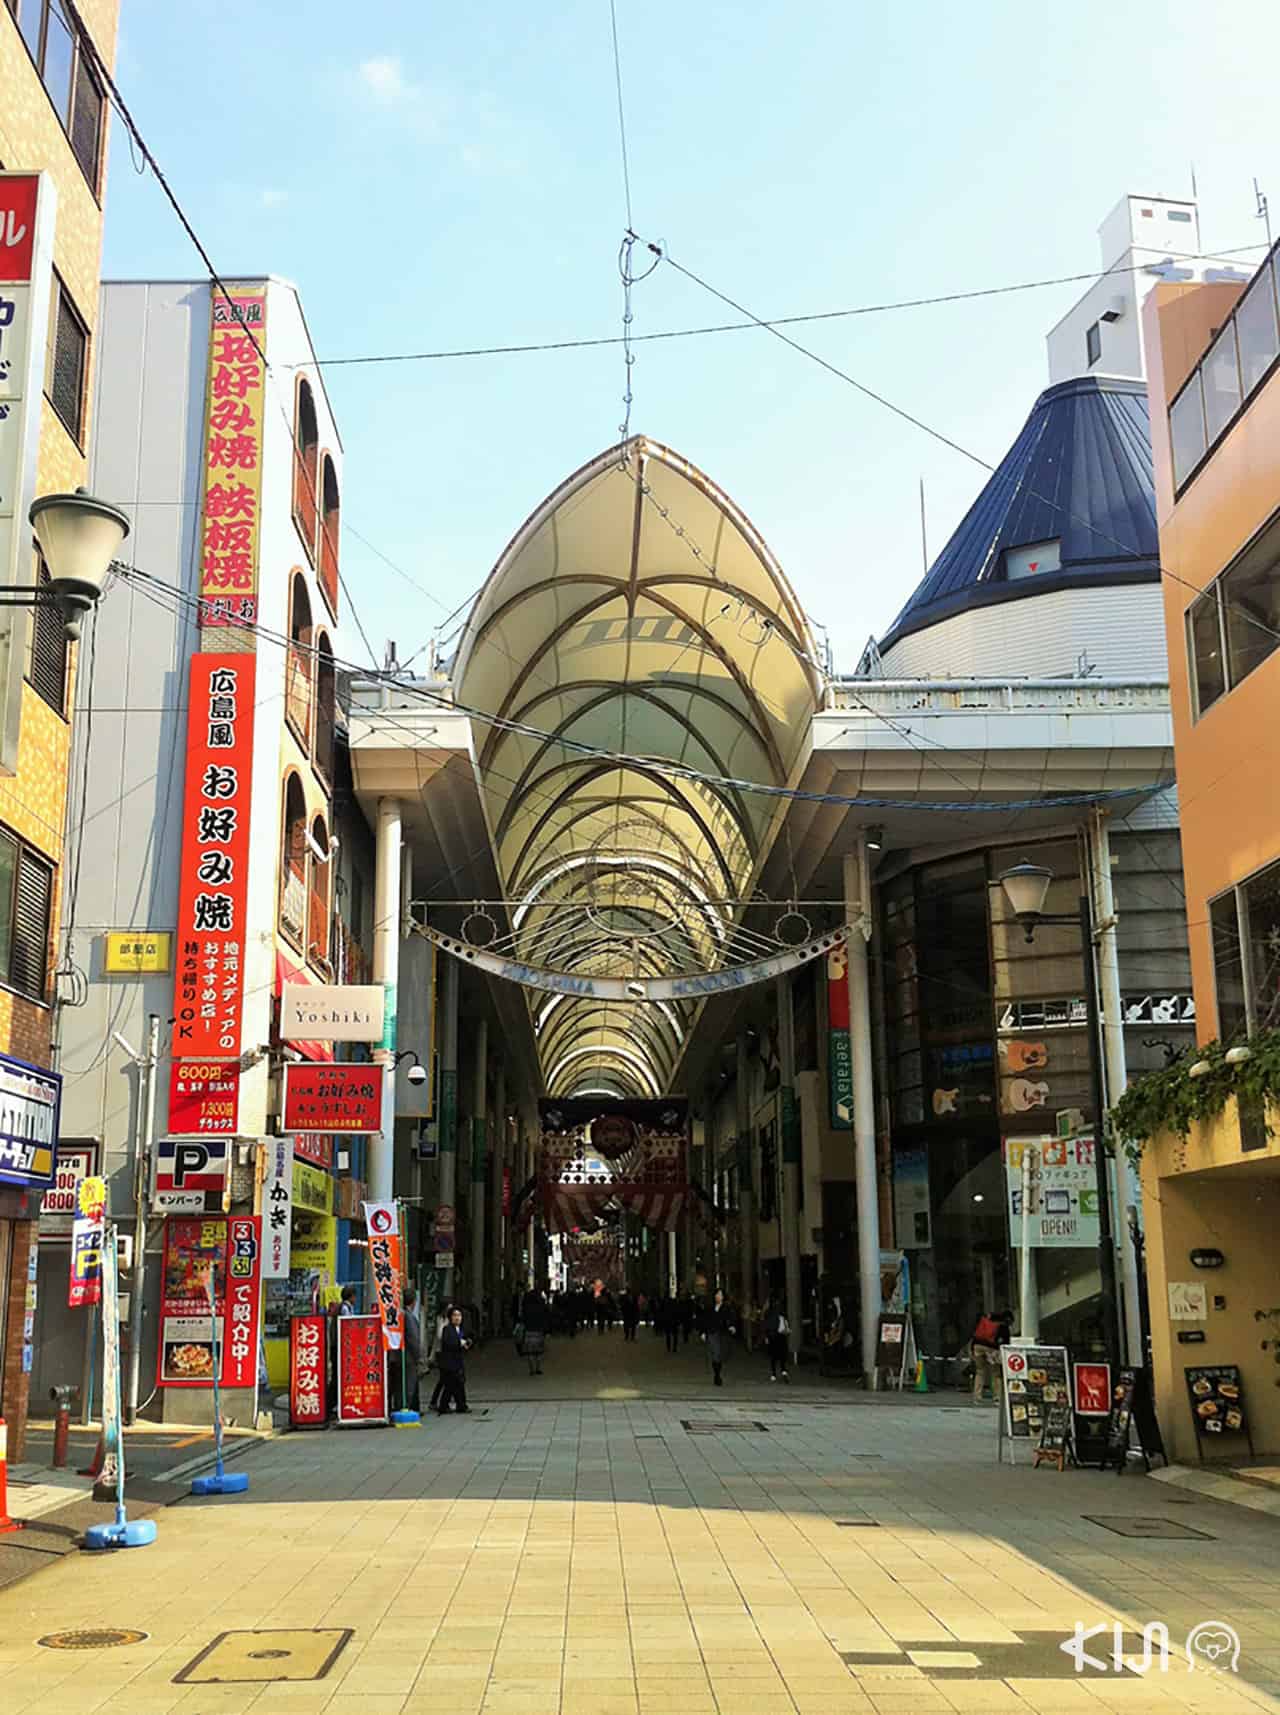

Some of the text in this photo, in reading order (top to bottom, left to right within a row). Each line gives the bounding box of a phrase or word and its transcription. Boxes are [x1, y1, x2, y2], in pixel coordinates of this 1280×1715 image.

[192, 667, 237, 933] 広島風 お好み焼
[218, 941, 239, 1049] 地元メディアの
[296, 1010, 370, 1023] Yoshiki
[173, 1143, 209, 1188] P
[269, 1181, 289, 1230] かき
[295, 1323, 321, 1416] お好み焼
